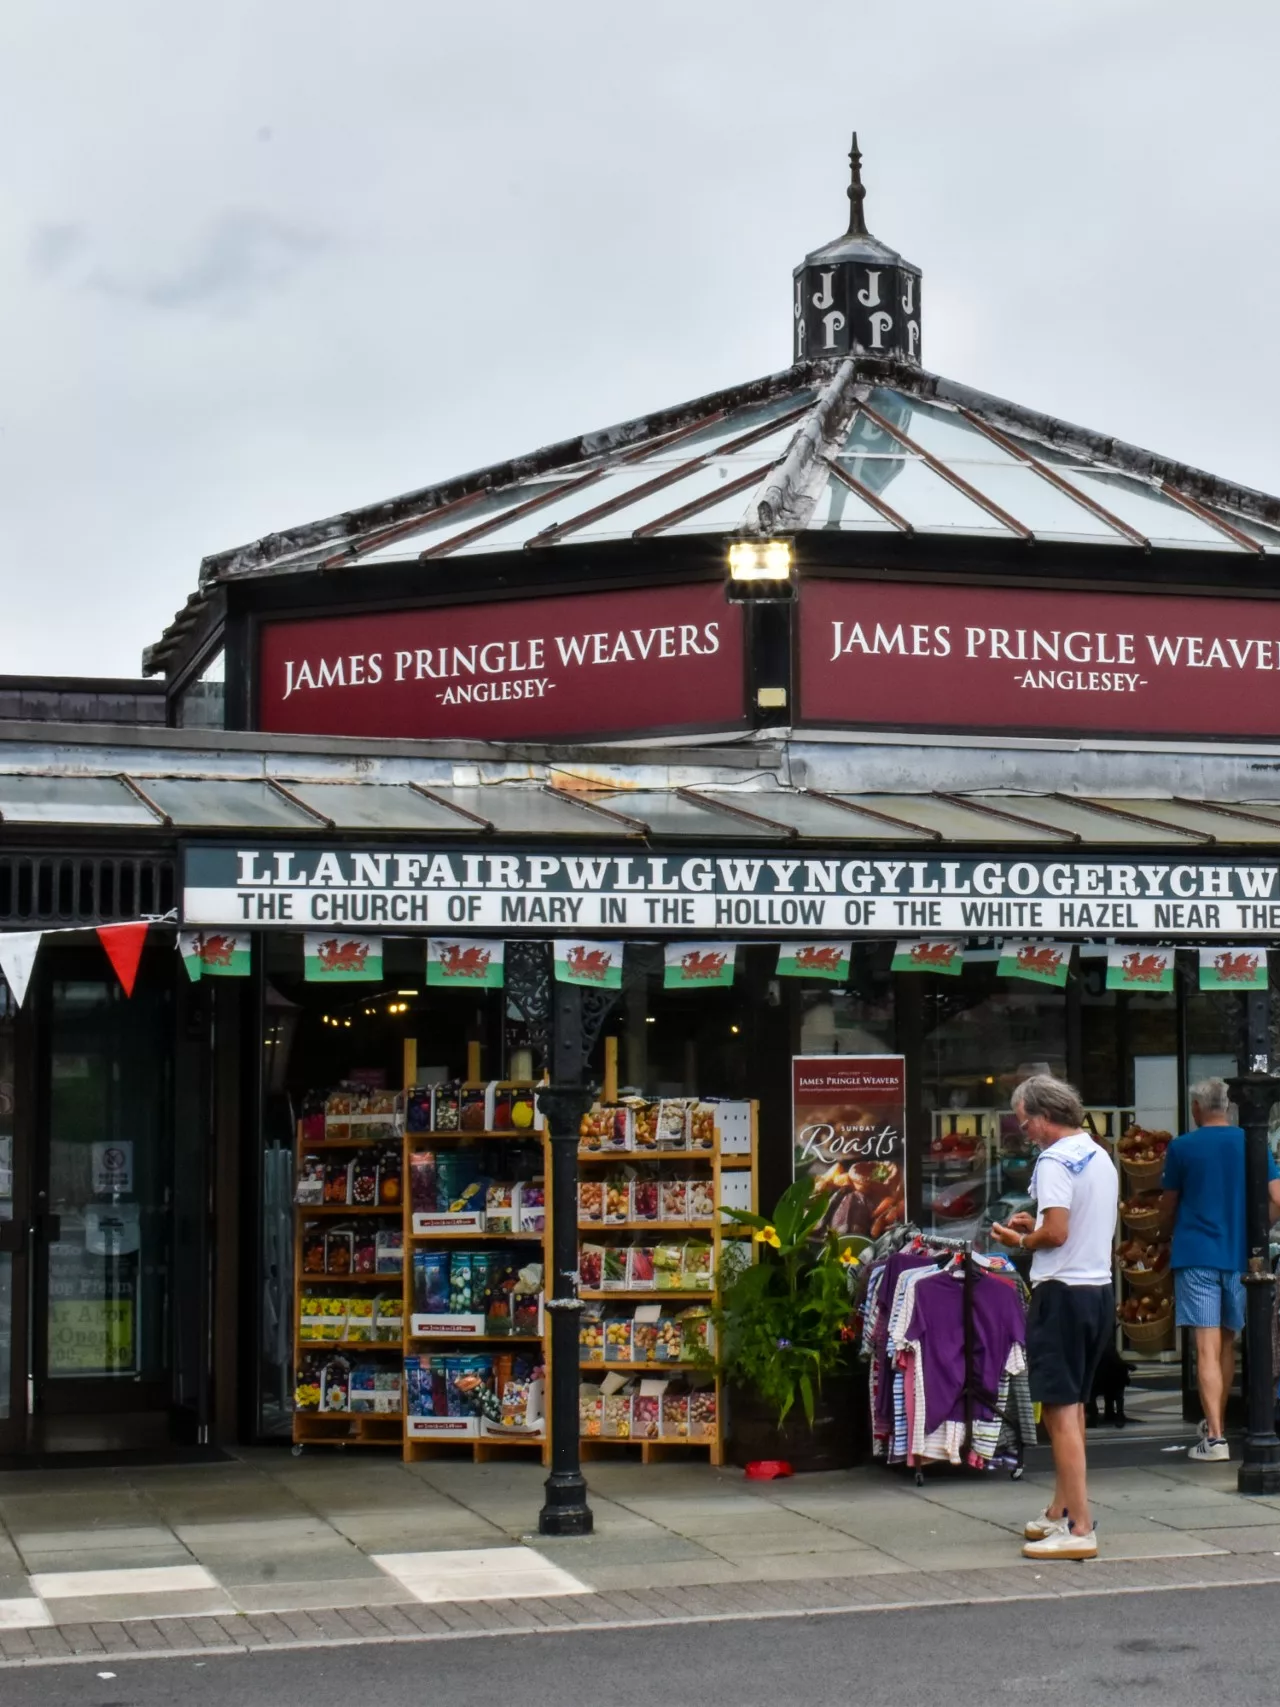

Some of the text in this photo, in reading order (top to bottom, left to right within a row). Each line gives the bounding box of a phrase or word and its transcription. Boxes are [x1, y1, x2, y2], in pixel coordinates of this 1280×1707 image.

[282, 621, 720, 701] JAMES PRINGLE WEAVERS
[829, 620, 951, 662] JAMES
[965, 626, 1137, 665] PRINGLE
[238, 893, 292, 920] THE
[312, 894, 427, 922] CHURCH
[448, 896, 481, 922] OF
[502, 897, 582, 923] MARY
[601, 898, 626, 924] IN
[645, 899, 694, 924] THE
[716, 899, 824, 926] HOLLOW
[846, 901, 875, 926] OF
[894, 901, 941, 926] THE
[961, 902, 1042, 927] WHITE
[1060, 903, 1137, 928] HAZEL
[1155, 904, 1219, 929] NEAR
[827, 1077, 861, 1085] PRINGLE
[863, 1076, 899, 1085] WEAVERS
[800, 1124, 898, 1164] Roasts
